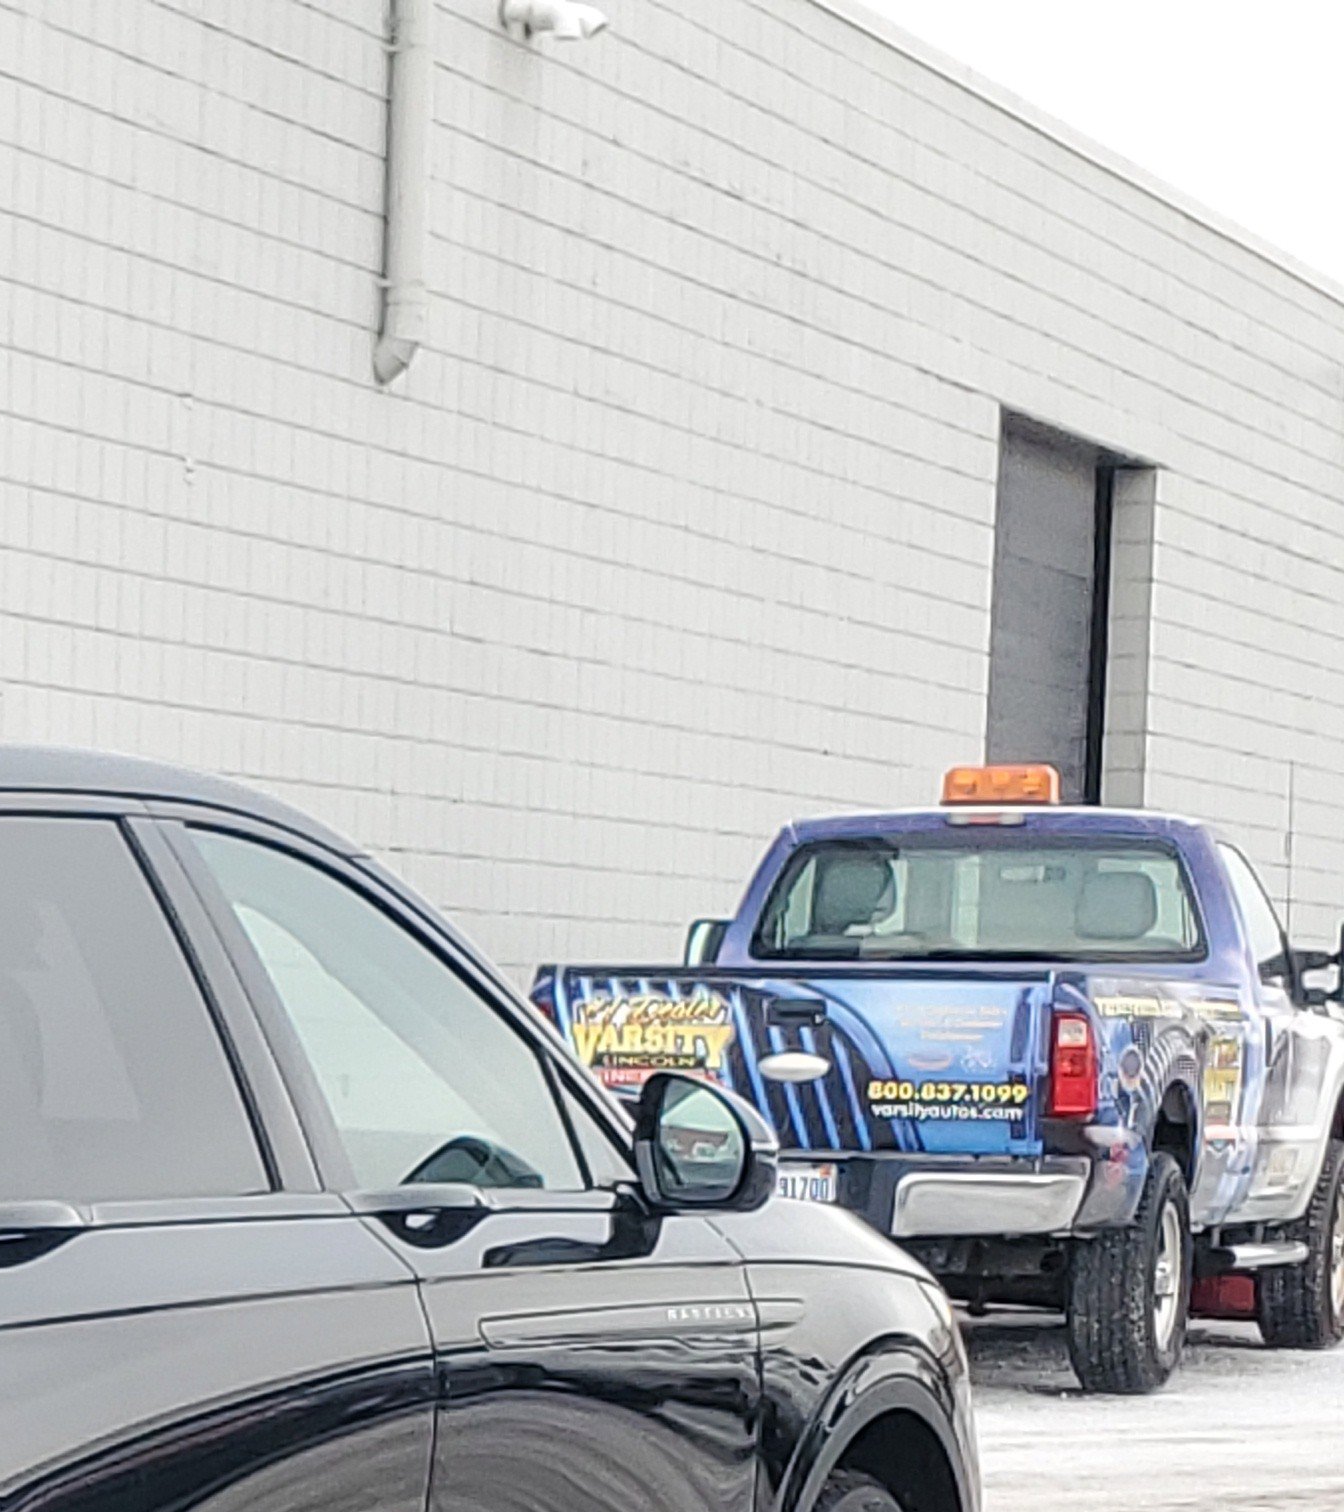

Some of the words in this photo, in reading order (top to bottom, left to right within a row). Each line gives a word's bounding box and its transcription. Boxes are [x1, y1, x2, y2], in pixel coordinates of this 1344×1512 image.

[572, 1023, 732, 1069] VARSITY
[603, 1056, 696, 1068] LINCOLN
[867, 1080, 1029, 1103] 800.837.1099
[870, 1101, 1024, 1121] varsityautos.com
